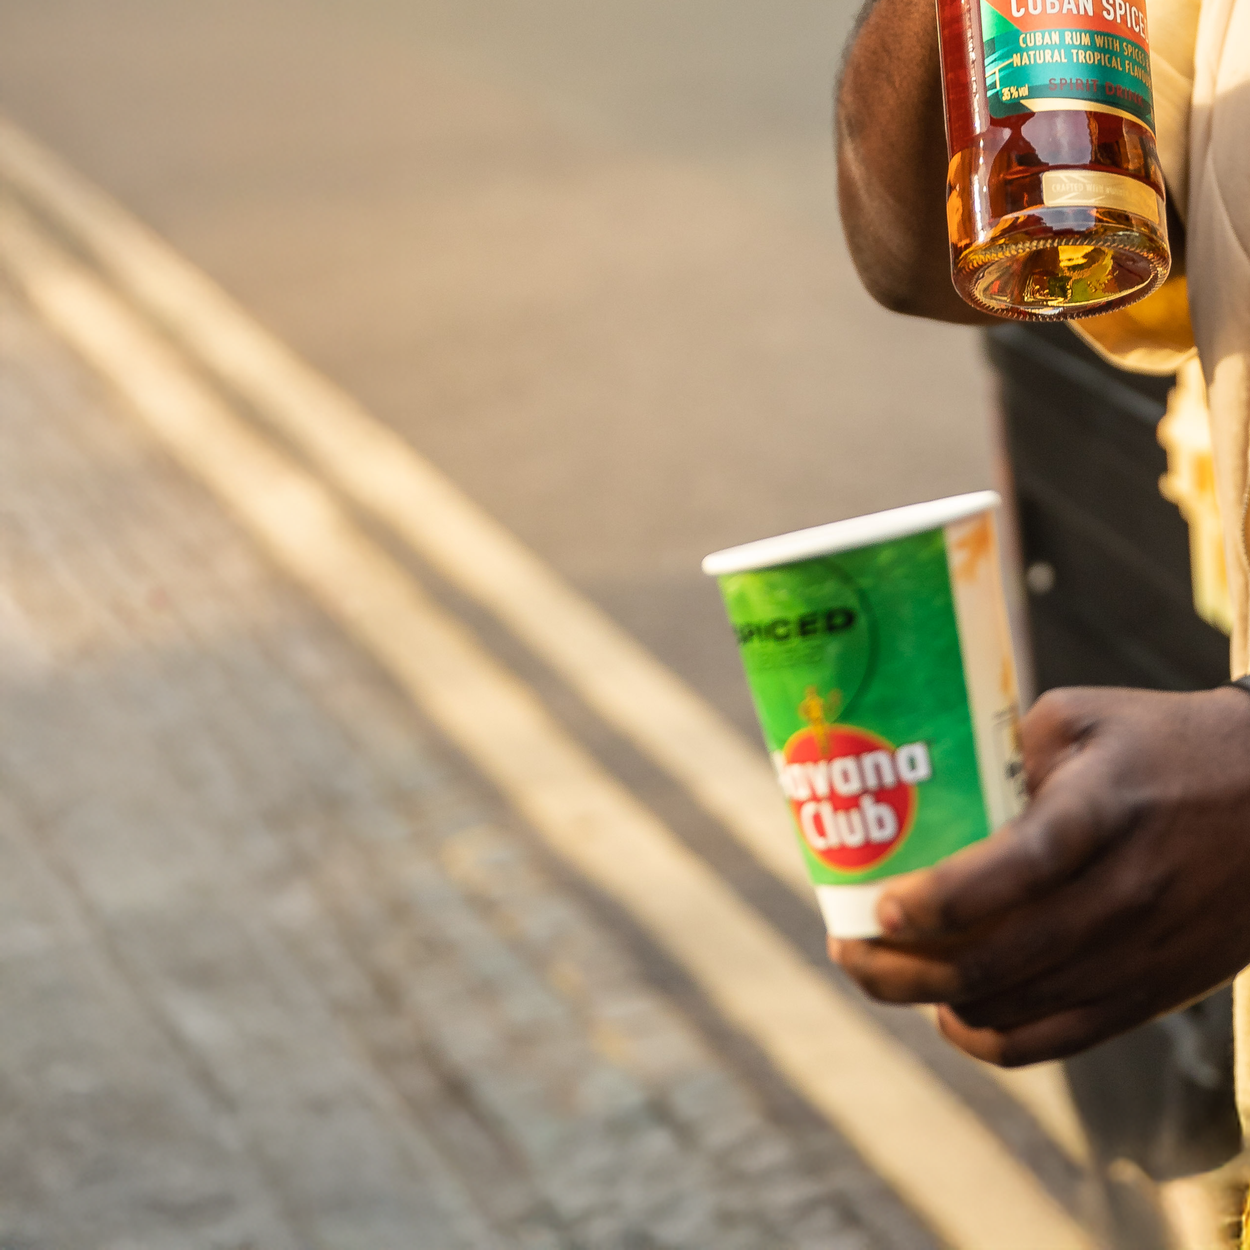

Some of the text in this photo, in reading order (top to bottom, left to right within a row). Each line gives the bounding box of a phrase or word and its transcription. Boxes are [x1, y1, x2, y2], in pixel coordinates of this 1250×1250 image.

[1019, 31, 1060, 48] CUBAN
[1064, 31, 1091, 46] RUM
[1094, 34, 1120, 53] WITH
[1013, 49, 1068, 67] NATURAL
[1071, 49, 1123, 71] TROPICAL
[1048, 77, 1144, 107] SPIRIT DRINK
[1051, 183, 1084, 193] CRAFTED
[800, 793, 899, 851] Club
